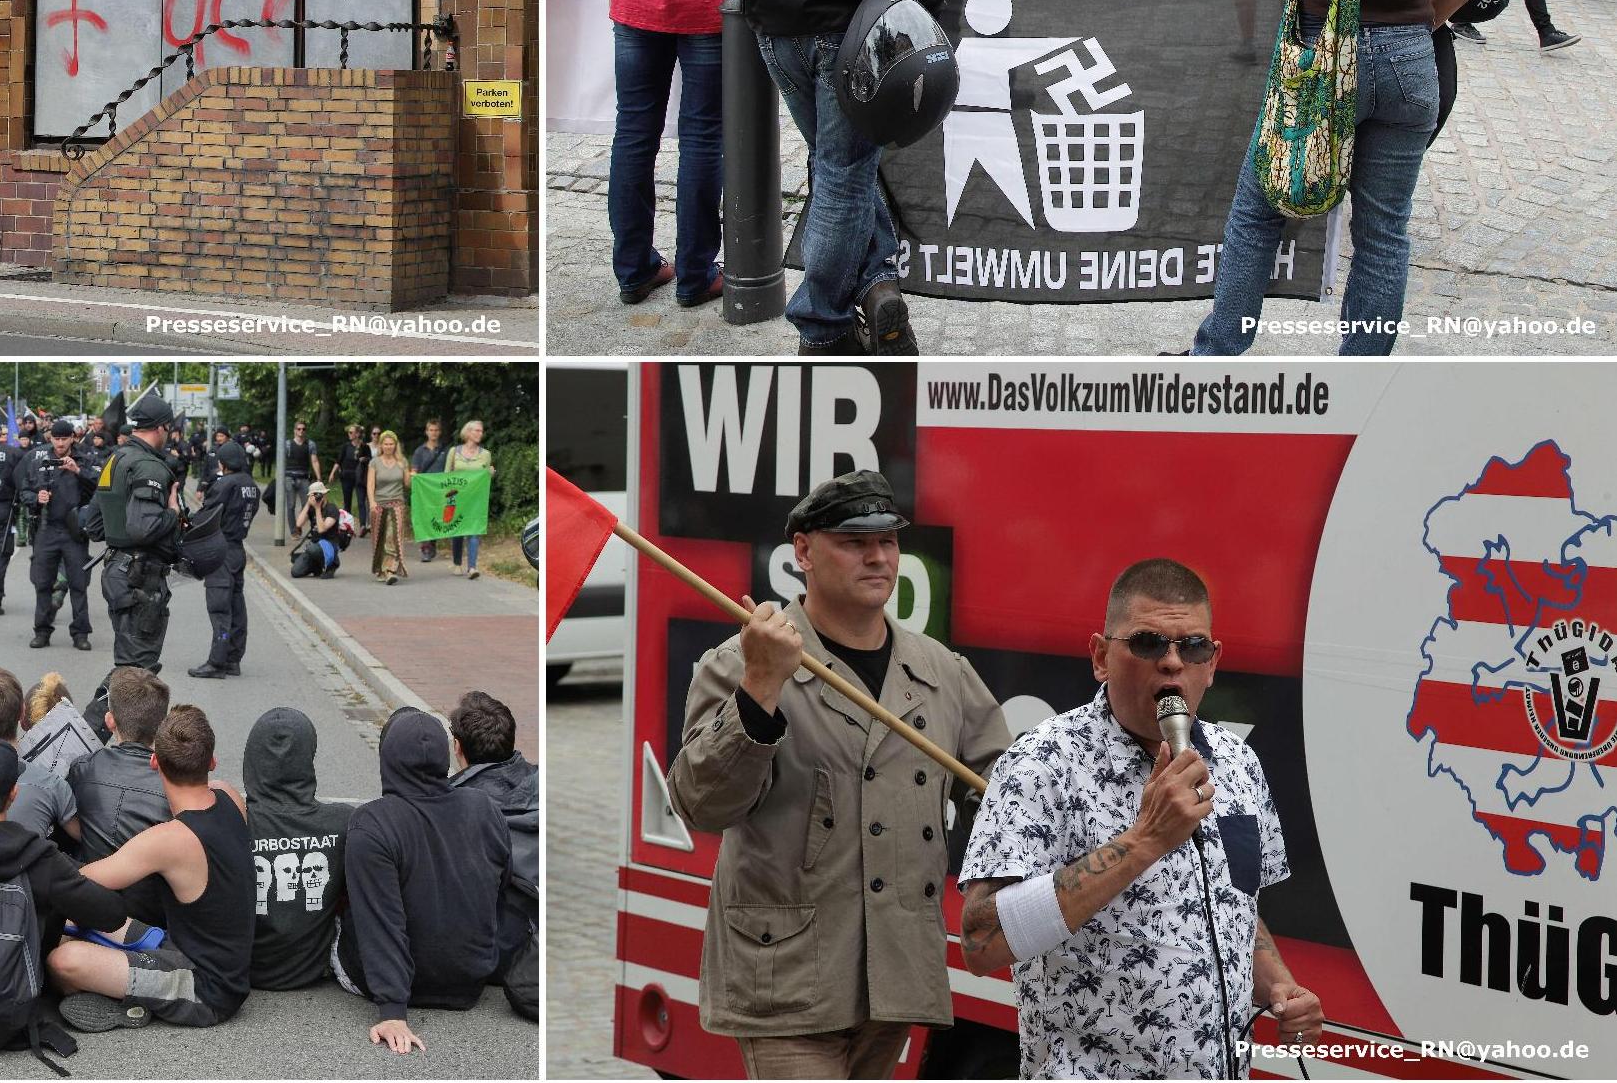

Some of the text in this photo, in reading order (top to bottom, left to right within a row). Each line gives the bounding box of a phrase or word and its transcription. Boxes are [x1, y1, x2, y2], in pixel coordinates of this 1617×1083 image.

[470, 99, 514, 109] verboten!
[476, 88, 508, 98] Parken
[928, 372, 1330, 415] www.DasVolkzumWiderstand.de
[678, 365, 880, 497] WIR
